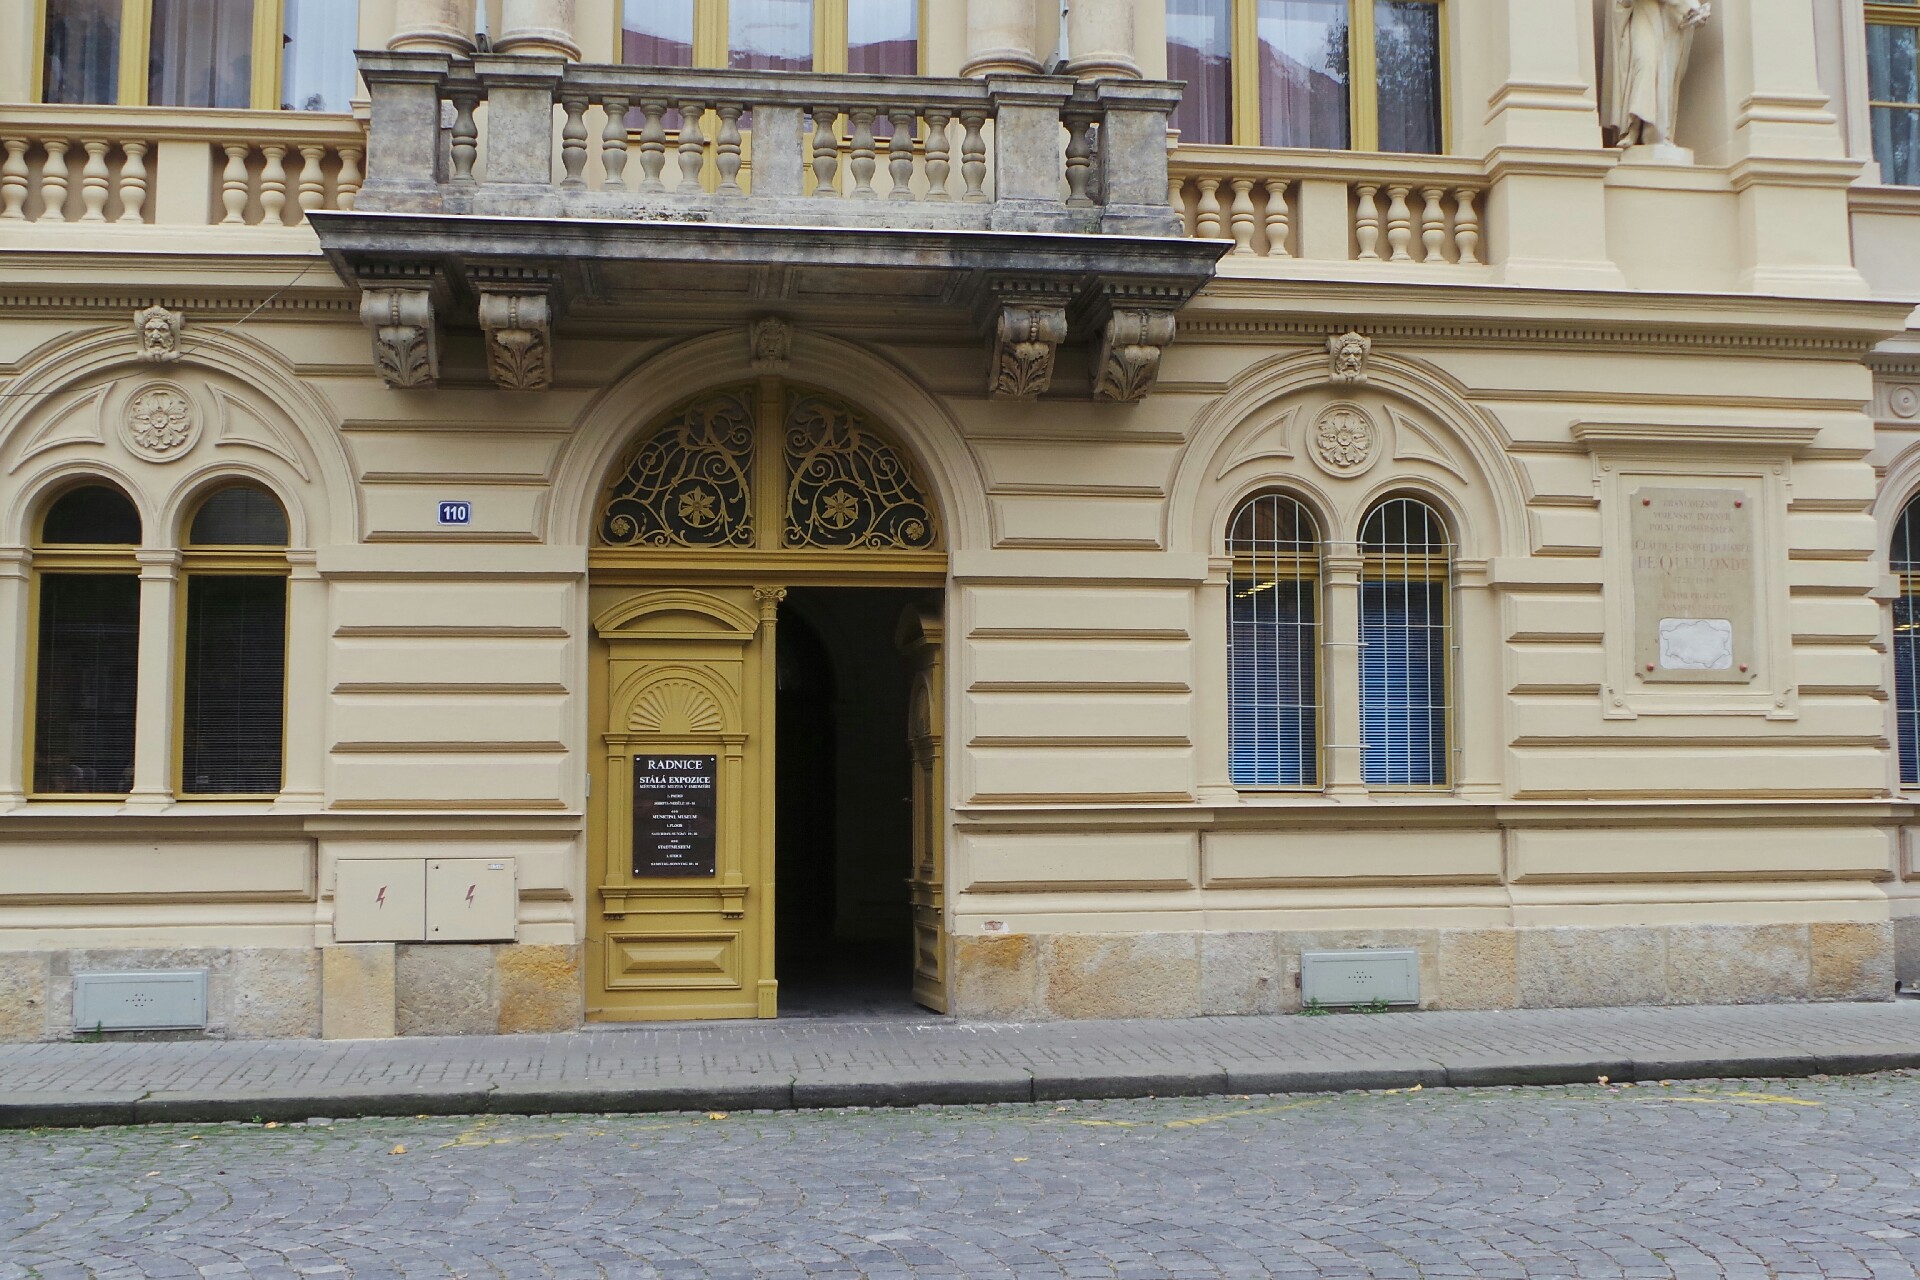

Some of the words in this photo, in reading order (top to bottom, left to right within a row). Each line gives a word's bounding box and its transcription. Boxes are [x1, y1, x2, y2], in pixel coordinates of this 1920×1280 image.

[443, 506, 466, 521] 110
[1638, 556, 1656, 569] DE
[647, 760, 703, 770] RADNICE
[639, 774, 667, 784] STÁLÁ
[668, 776, 711, 784] EXPOZICE
